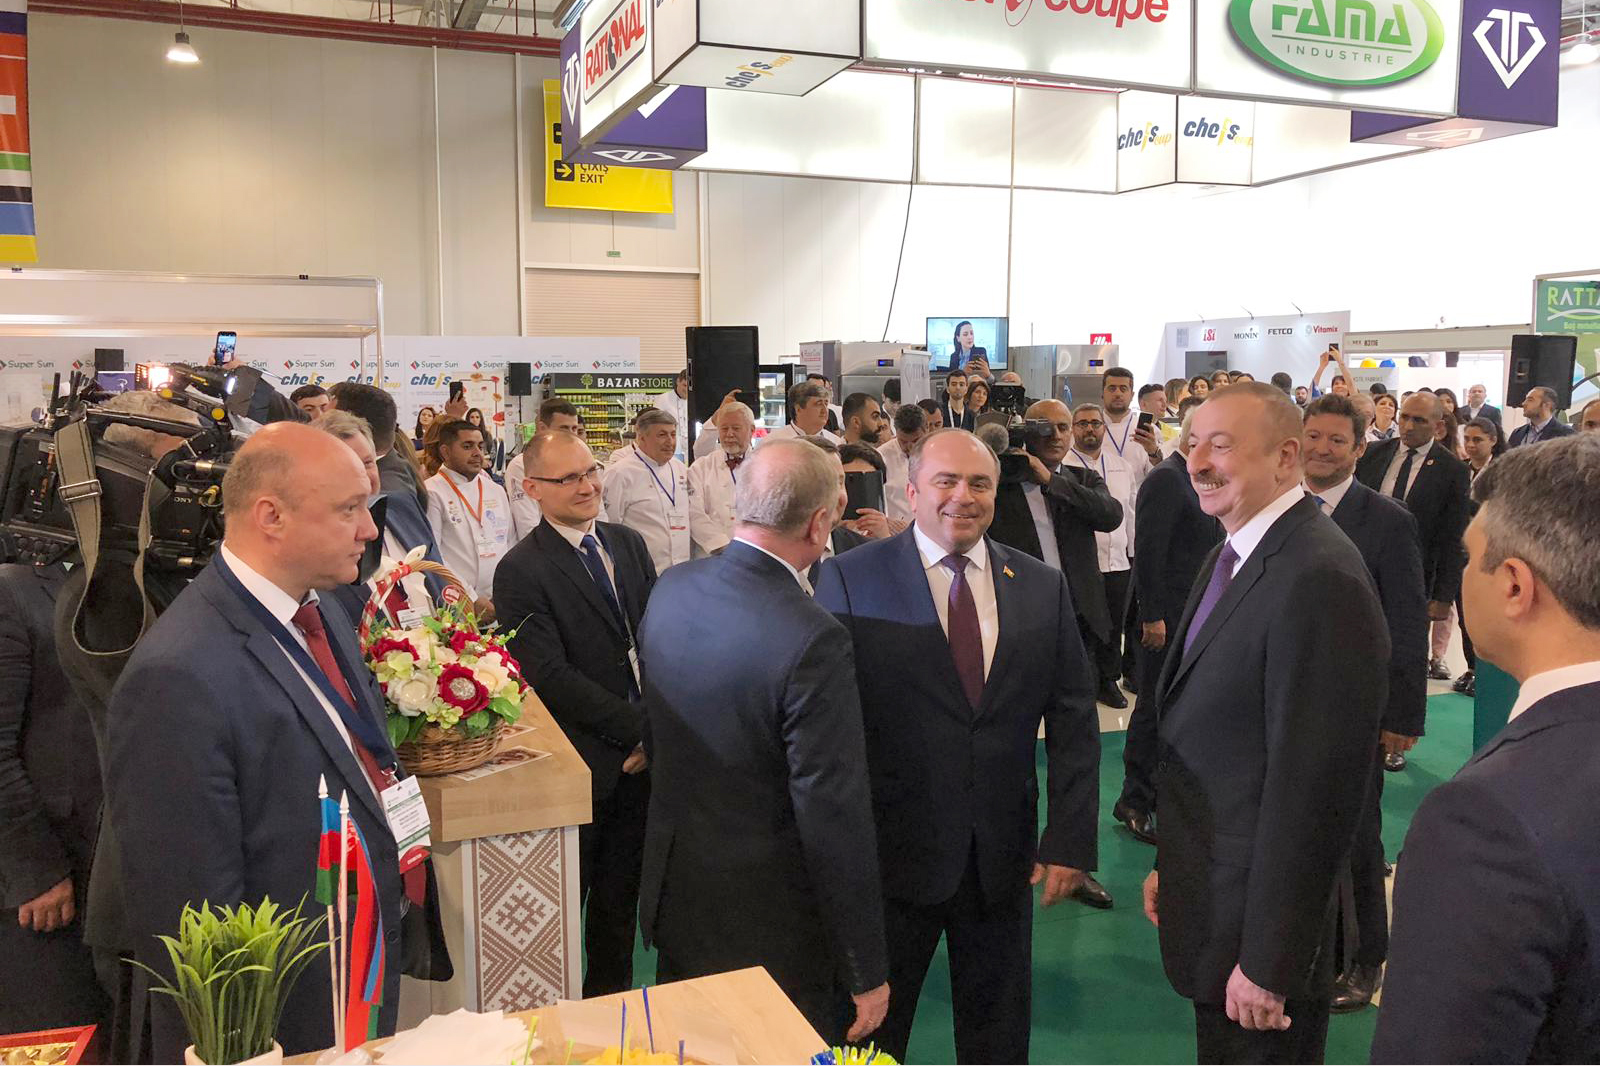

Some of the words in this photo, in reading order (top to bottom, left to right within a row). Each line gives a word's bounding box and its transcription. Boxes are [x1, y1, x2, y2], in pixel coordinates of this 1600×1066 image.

[1272, 0, 1412, 46] FAMA
[585, 0, 645, 90] RATIONAL
[1287, 44, 1395, 65] INDUSTRIE
[580, 174, 604, 184] EXIT
[1267, 327, 1293, 336] FETCO
[1313, 324, 1339, 334] Vitamix
[1234, 331, 1258, 340] MONIN
[8, 360, 33, 369] Super
[37, 360, 54, 368] Sun
[252, 360, 267, 368] Sun
[295, 360, 317, 369] Super
[319, 360, 334, 368] Sun
[385, 360, 400, 368] Sun
[421, 361, 441, 369] Super
[444, 361, 458, 369] Sun
[483, 361, 503, 369] Super
[543, 361, 563, 370] Super
[602, 361, 620, 369] Super
